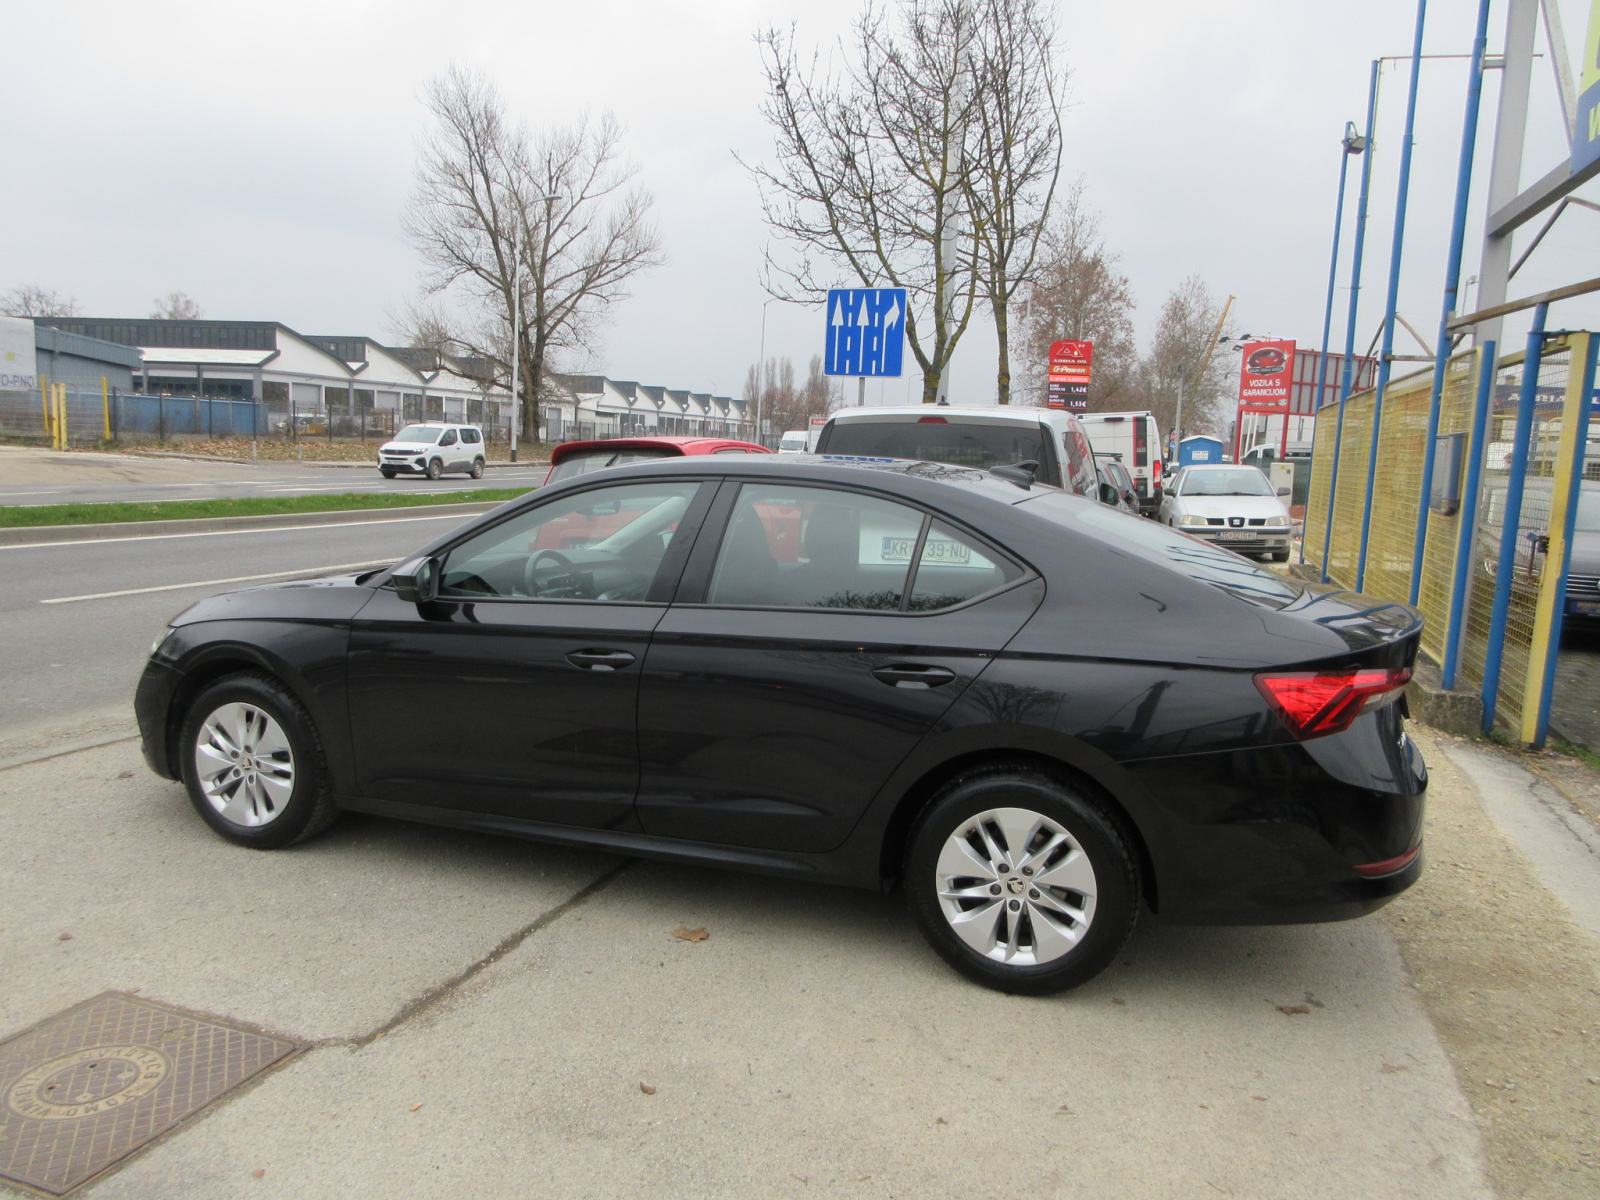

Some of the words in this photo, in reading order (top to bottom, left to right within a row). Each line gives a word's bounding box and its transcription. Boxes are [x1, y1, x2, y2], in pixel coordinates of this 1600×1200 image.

[1249, 379, 1273, 387] VOZILA
[1242, 388, 1286, 396] GARANCIJOM
[891, 541, 908, 556] KR
